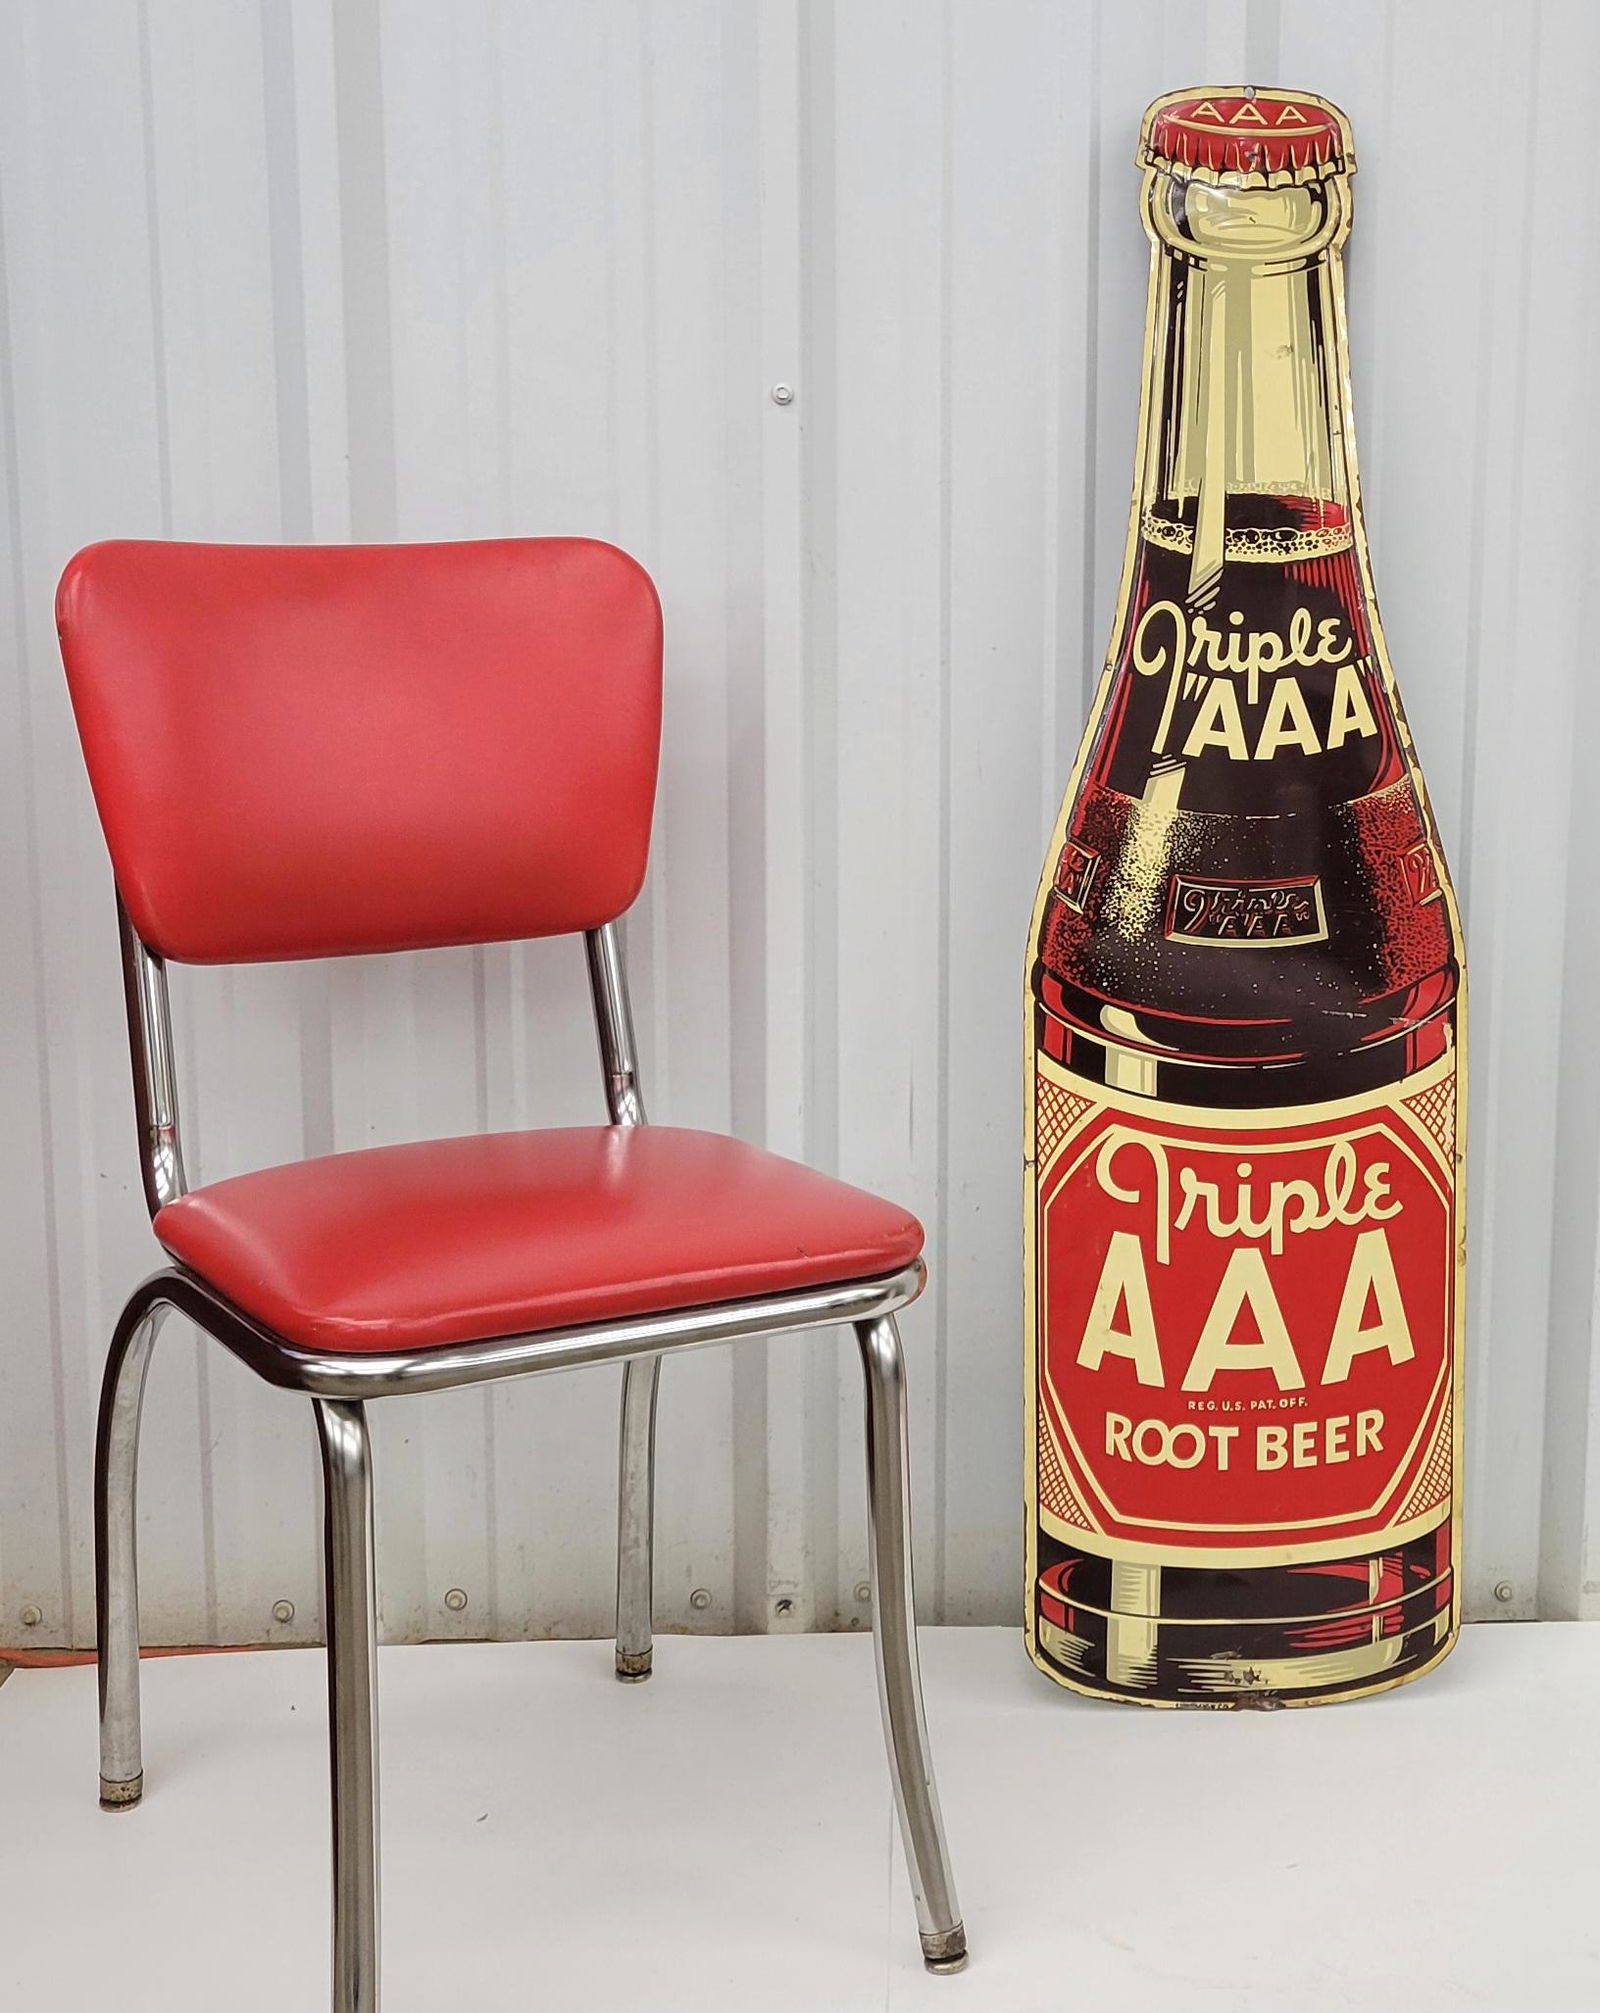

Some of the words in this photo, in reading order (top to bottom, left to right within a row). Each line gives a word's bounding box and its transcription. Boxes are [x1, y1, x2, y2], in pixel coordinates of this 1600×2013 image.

[1190, 100, 1308, 127] AAA
[1132, 600, 1353, 755] Triple
[1095, 1134, 1404, 1267] Triple
[1075, 1226, 1416, 1393] AAA
[1105, 1411, 1240, 1471] ROOT
[1255, 1409, 1385, 1471] BEER
[1187, 1400, 1219, 1411] REG.
[1221, 1400, 1246, 1411] U.S.
[1250, 1399, 1277, 1410] PAT.
[1279, 1396, 1309, 1408] OFF.
